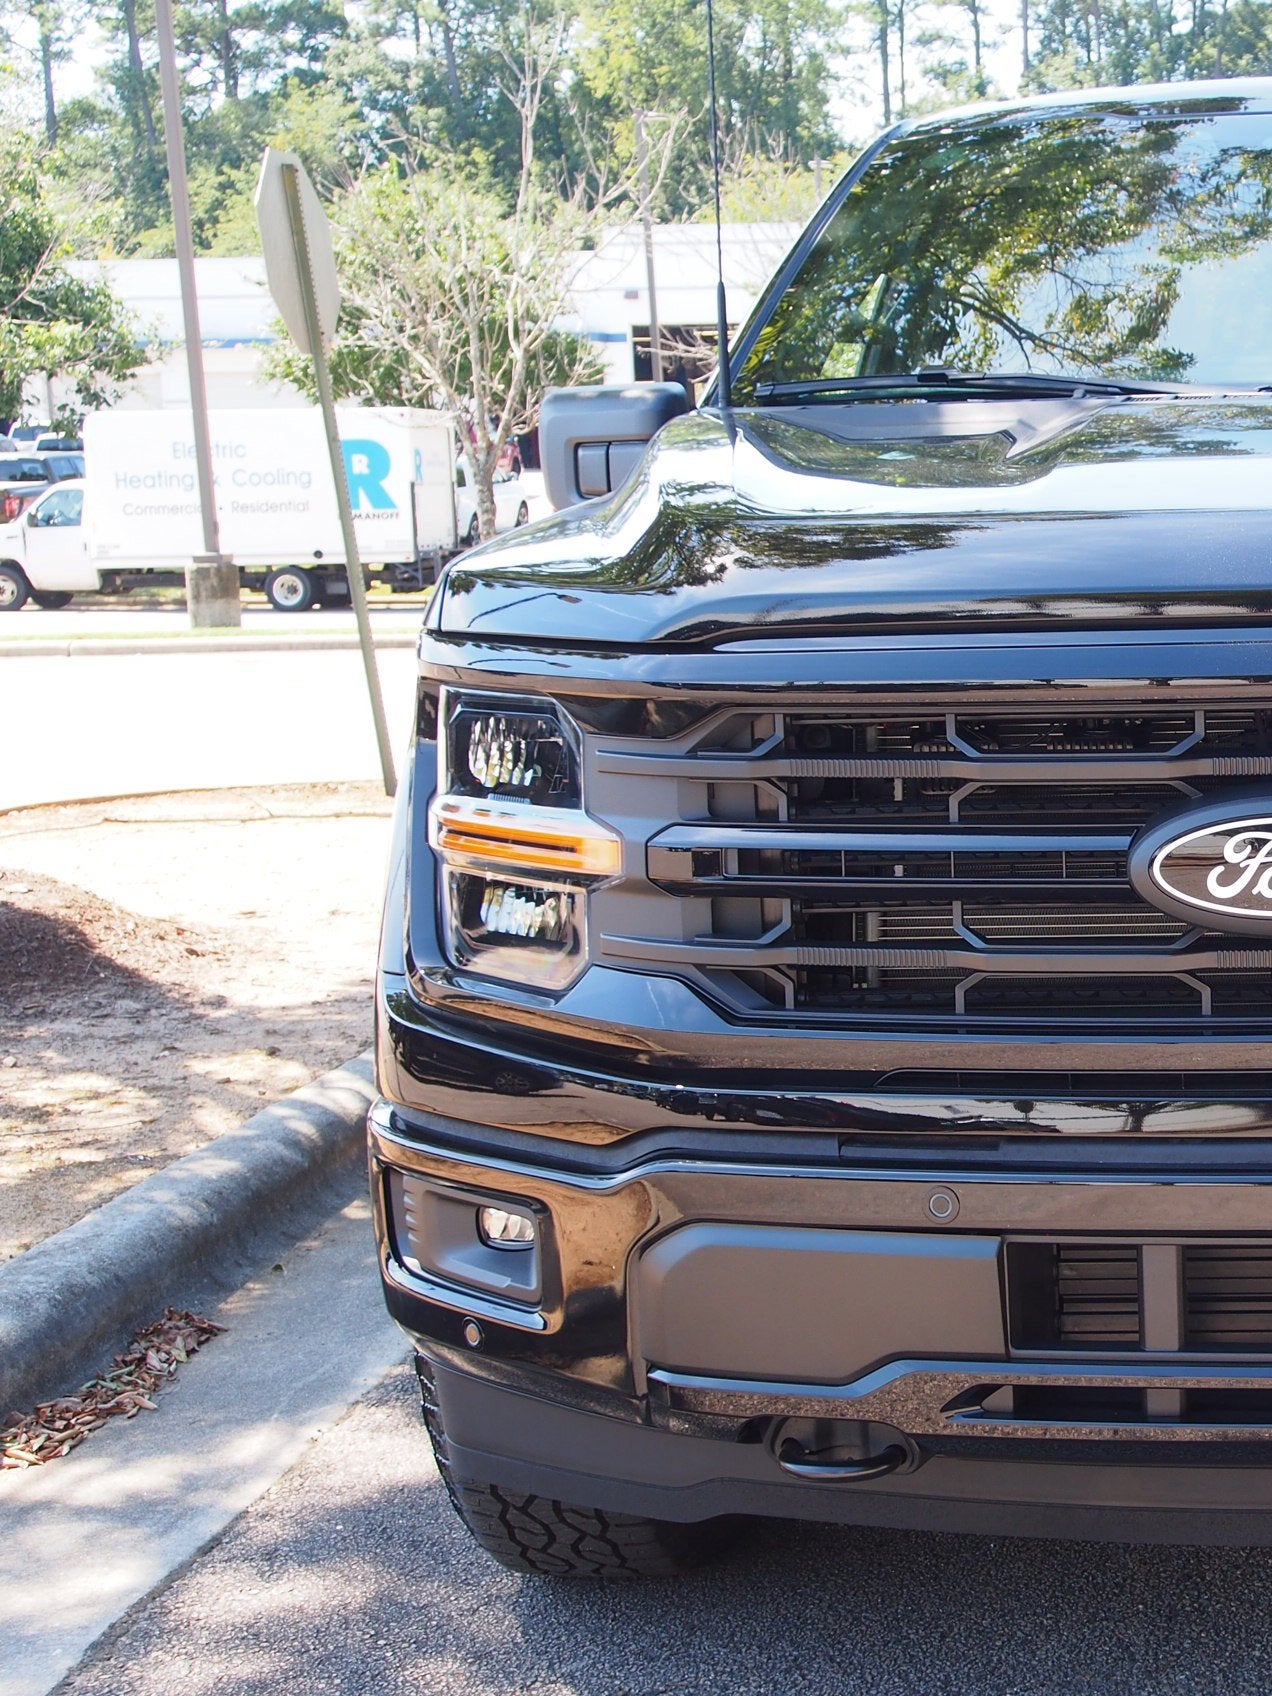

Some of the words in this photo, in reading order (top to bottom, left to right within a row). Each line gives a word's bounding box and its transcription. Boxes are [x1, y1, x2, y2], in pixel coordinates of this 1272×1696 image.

[172, 440, 247, 459] Eletric
[352, 454, 369, 474] R
[115, 470, 195, 492] Heating
[232, 468, 313, 489] Cooling
[341, 438, 399, 510] R
[122, 502, 203, 516] Commerci
[231, 500, 310, 514] Residential
[340, 511, 400, 520] MANOFF
